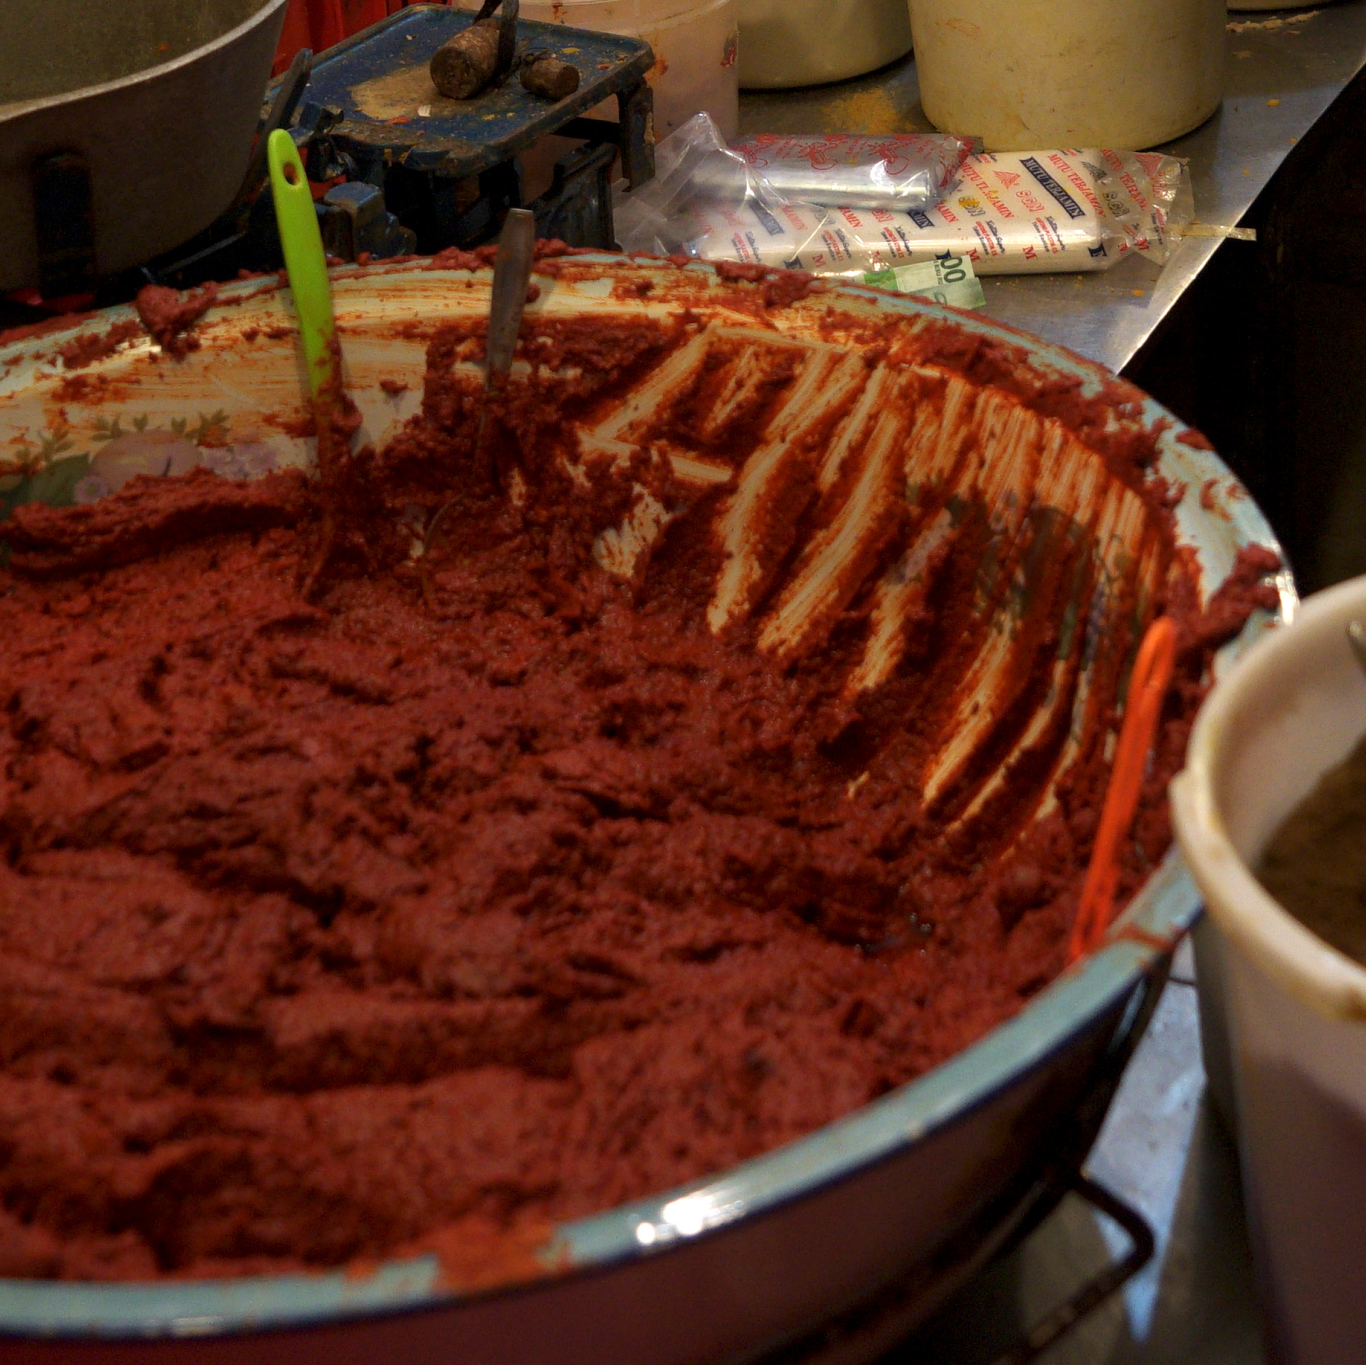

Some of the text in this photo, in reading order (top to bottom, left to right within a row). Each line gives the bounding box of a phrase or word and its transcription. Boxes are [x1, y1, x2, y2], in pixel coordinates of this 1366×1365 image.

[1025, 158, 1052, 182] MUTU
[1045, 177, 1085, 218] TERJAMIN
[1048, 154, 1071, 173] MUTU
[1067, 172, 1106, 218] TERJAMIN
